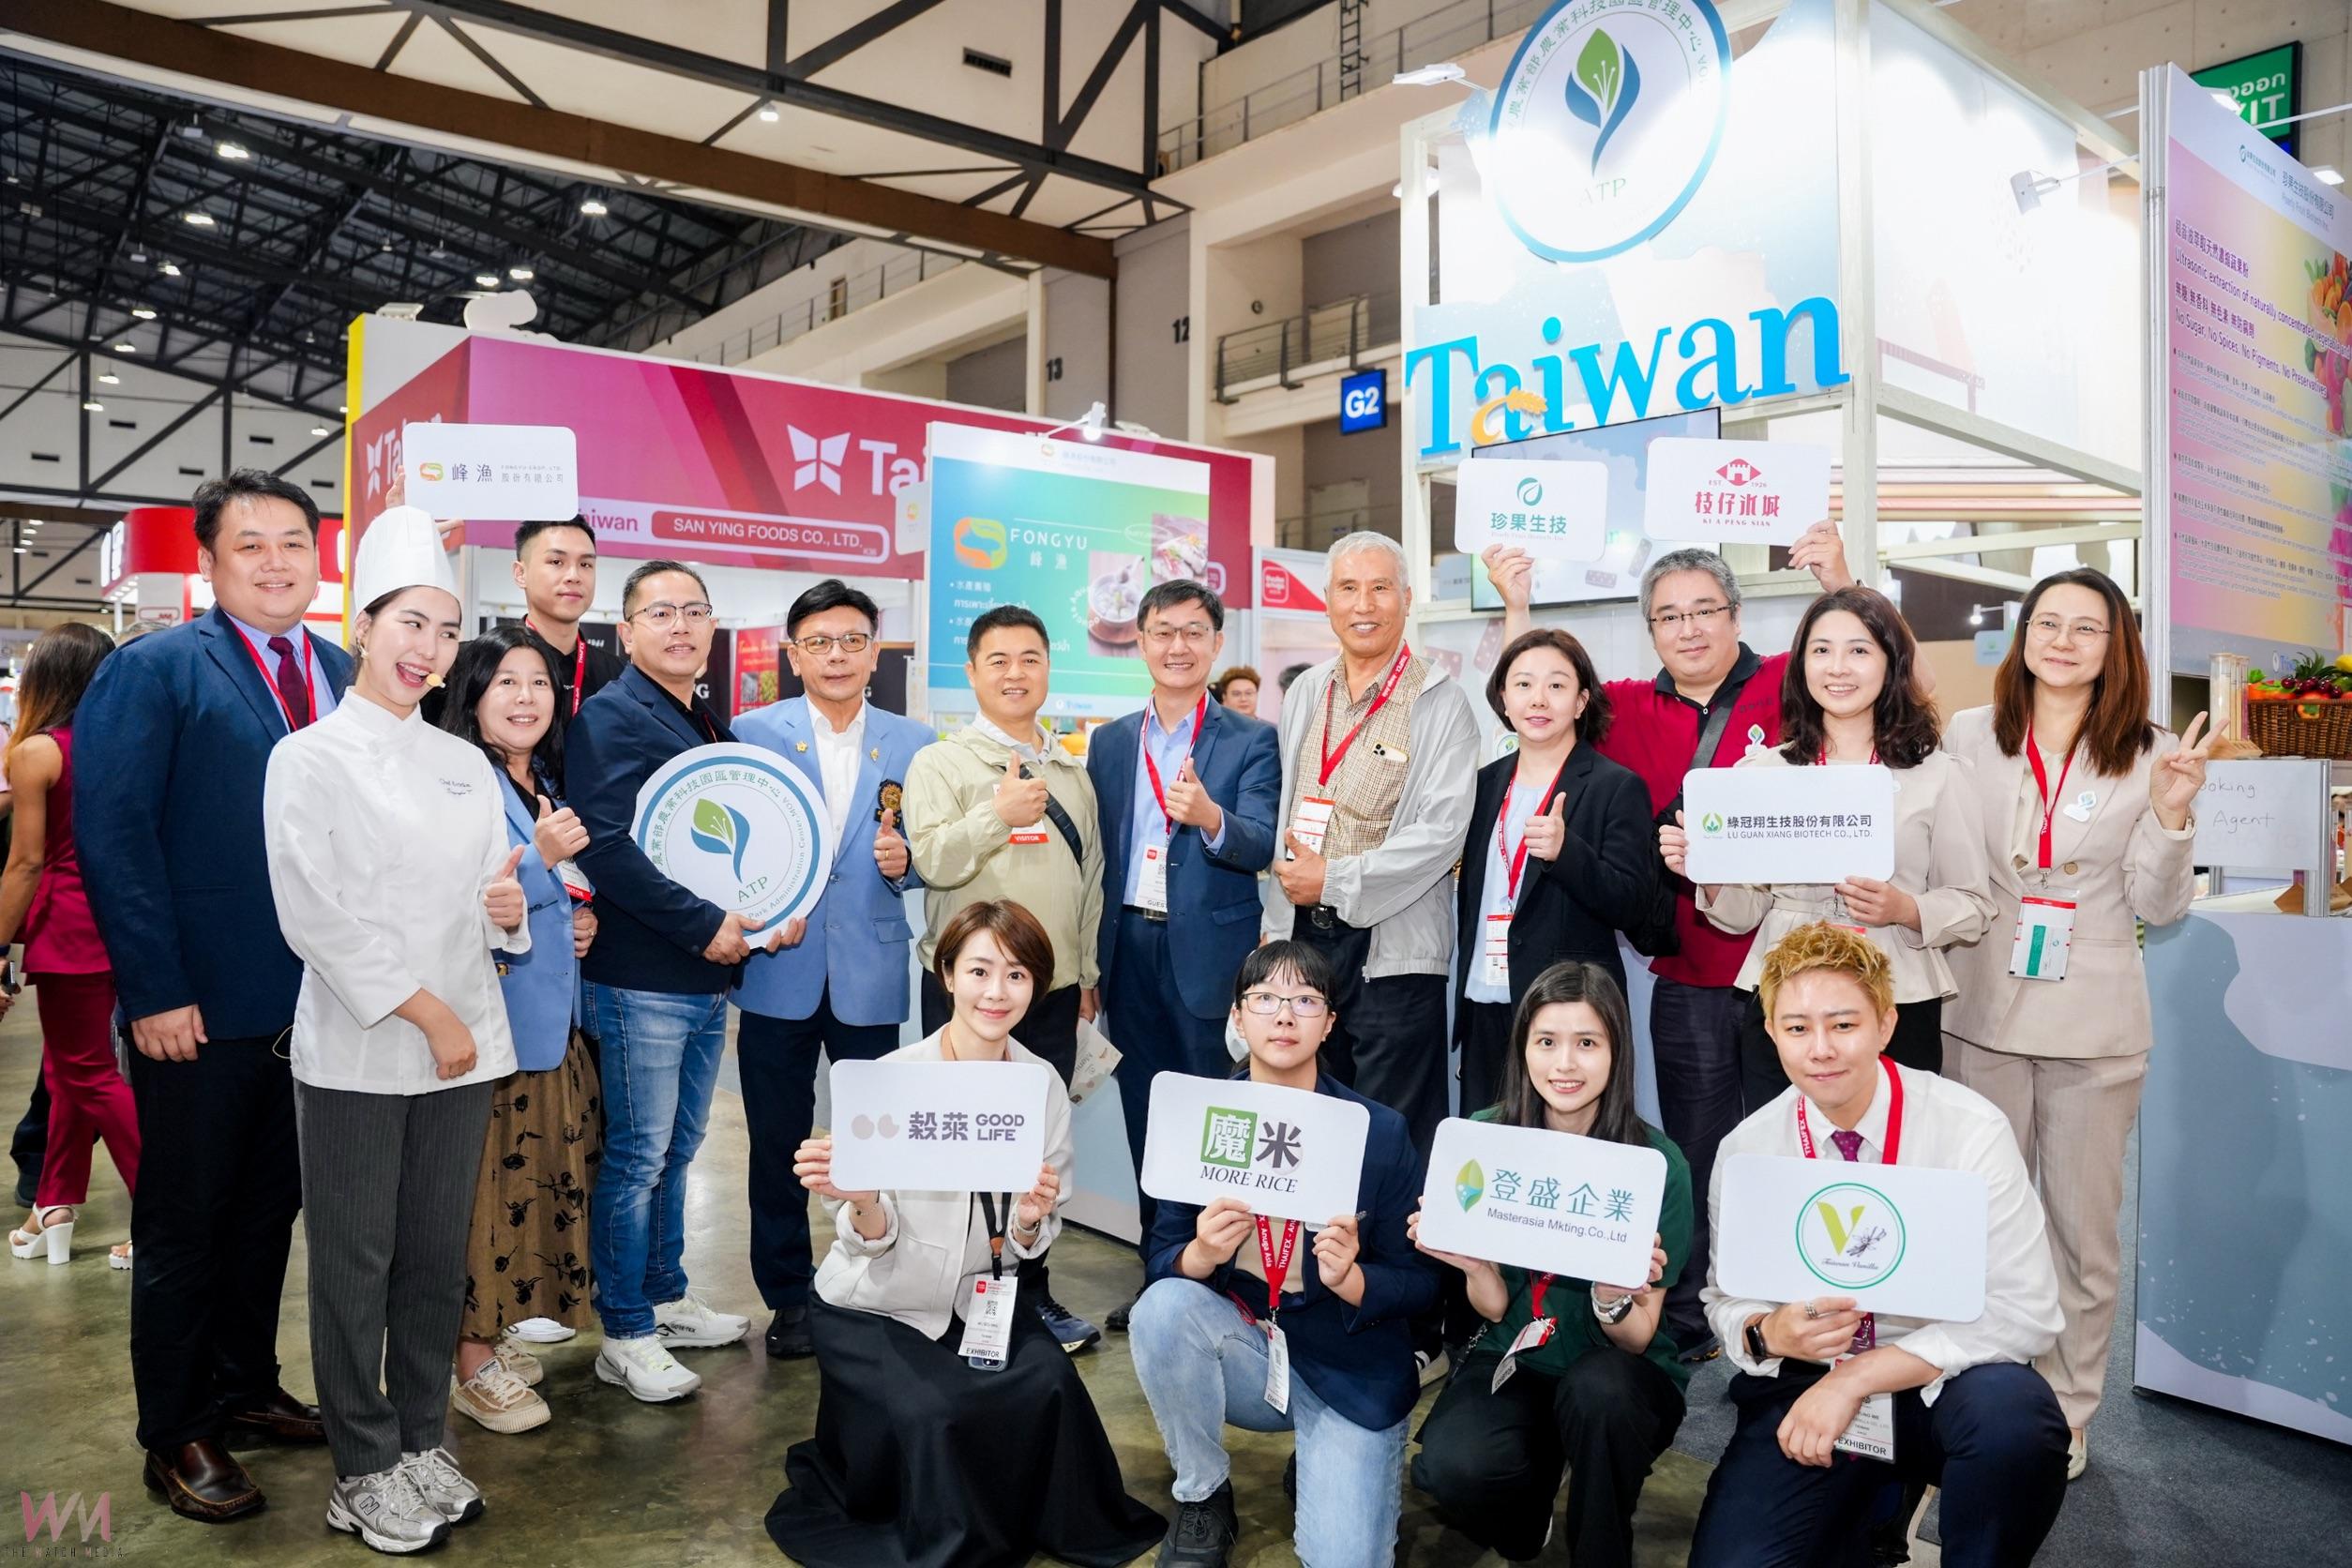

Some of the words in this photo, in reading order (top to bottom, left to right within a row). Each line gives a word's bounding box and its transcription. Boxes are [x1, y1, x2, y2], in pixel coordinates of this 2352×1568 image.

[2176, 246, 2208, 279] Ultrasonic
[2209, 272, 2241, 299] extraction
[2242, 289, 2249, 302] of
[2250, 294, 2276, 322] naturally
[2278, 310, 2314, 339] concentrated
[1172, 316, 1189, 344] 12
[2176, 307, 2185, 324] No
[2208, 325, 2217, 343] No
[2241, 343, 2251, 361] No
[2282, 364, 2292, 380] No
[2292, 369, 2328, 399] Preservatives
[1046, 357, 1063, 382] 13
[1405, 296, 1850, 457] Taiwan
[1345, 385, 1380, 419] G2
[452, 463, 492, 483] 峰漁
[501, 473, 564, 484] 股份有限公司
[673, 518, 704, 535] SAN
[708, 520, 745, 537] YING
[748, 524, 798, 543] FOODS
[833, 533, 863, 550] LTD.
[1490, 513, 1567, 535] 珍果生技
[1010, 528, 1088, 550] FONGYU
[782, 797, 797, 817] MOA
[1726, 814, 1872, 829] 綠冠翔生技股份有限公司
[2213, 809, 2275, 834] Agent
[1727, 831, 1739, 839] LU
[1766, 830, 1792, 838] XIANG
[1793, 830, 1832, 838] BIOTECH
[1854, 829, 1873, 838] LTD.
[738, 876, 768, 903] ATP
[770, 852, 806, 909] Administration
[748, 908, 768, 920] Park
[1147, 899, 1167, 908] GUES
[975, 1114, 1025, 1126] GOOD
[977, 1129, 1016, 1141] LIFE
[1204, 1113, 1302, 1168] 魔米
[1200, 1165, 1252, 1186] MORE
[1256, 1174, 1299, 1194] RICE
[1489, 1168, 1635, 1223] 登盛企業
[1487, 1207, 1545, 1228] Masterasia
[1278, 1238, 1292, 1269] THAIFEX
[966, 1347, 1000, 1358] EXHIBITOR
[1838, 1437, 1887, 1456] EXHIBITOR
